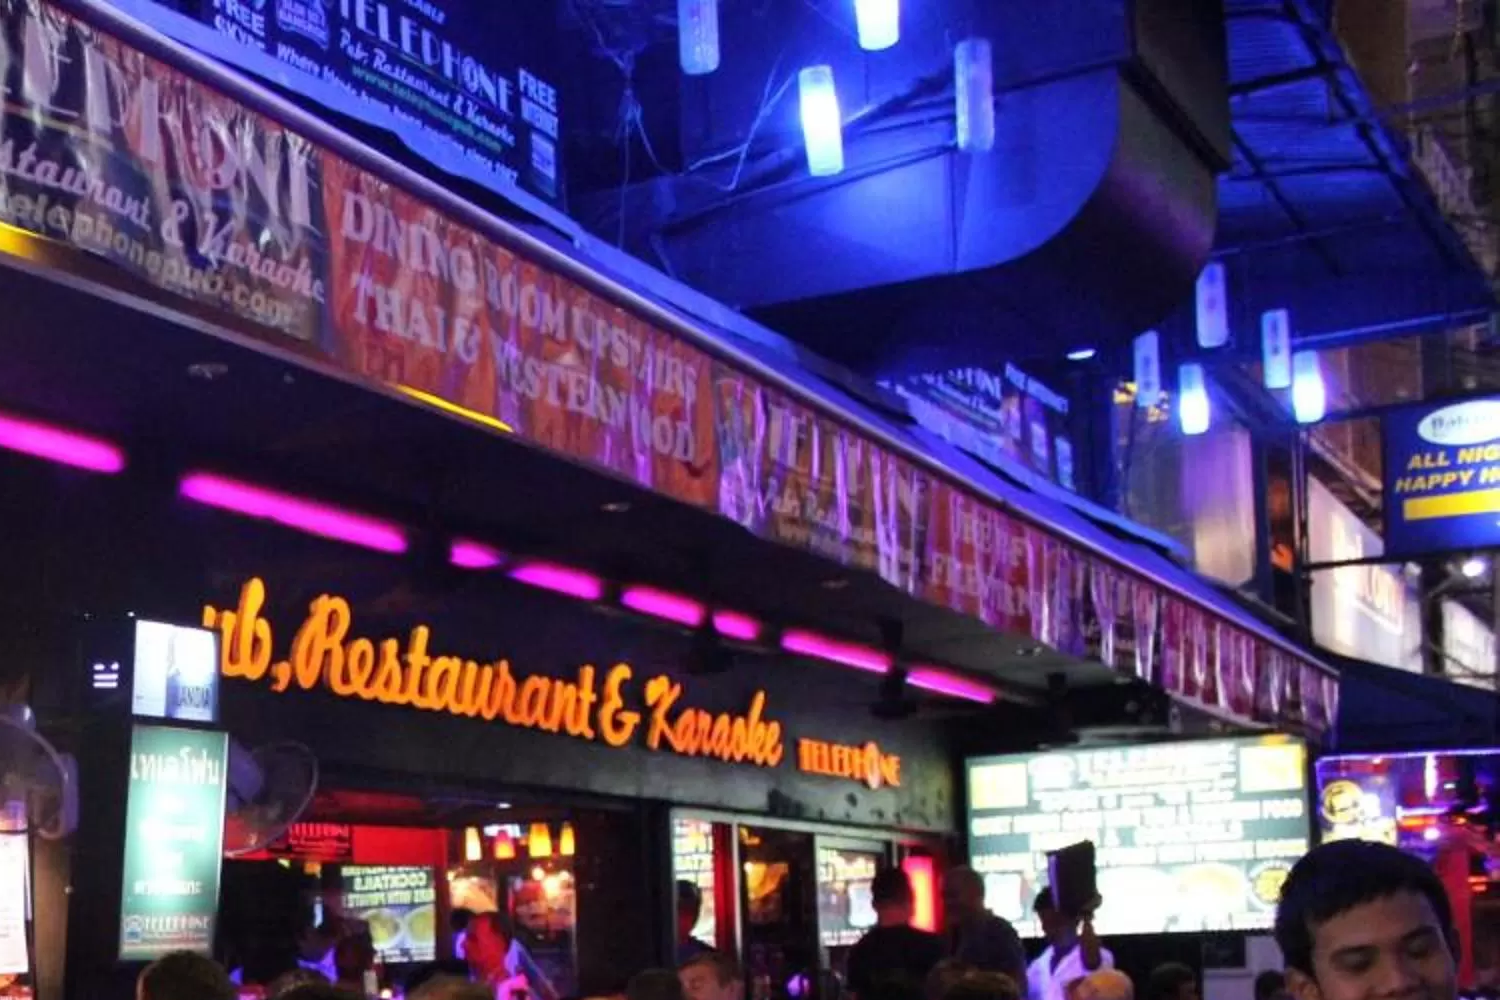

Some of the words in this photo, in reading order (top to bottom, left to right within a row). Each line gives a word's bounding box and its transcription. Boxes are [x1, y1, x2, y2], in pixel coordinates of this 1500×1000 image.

[341, 190, 480, 294] DINING
[351, 272, 447, 353] THAI
[1395, 469, 1476, 494] HAPPY
[1407, 452, 1451, 471] ALL
[284, 594, 597, 741] Restaurant
[600, 662, 641, 747] &
[645, 673, 784, 768] Karaoke
[797, 736, 901, 790] TELEPHONE
